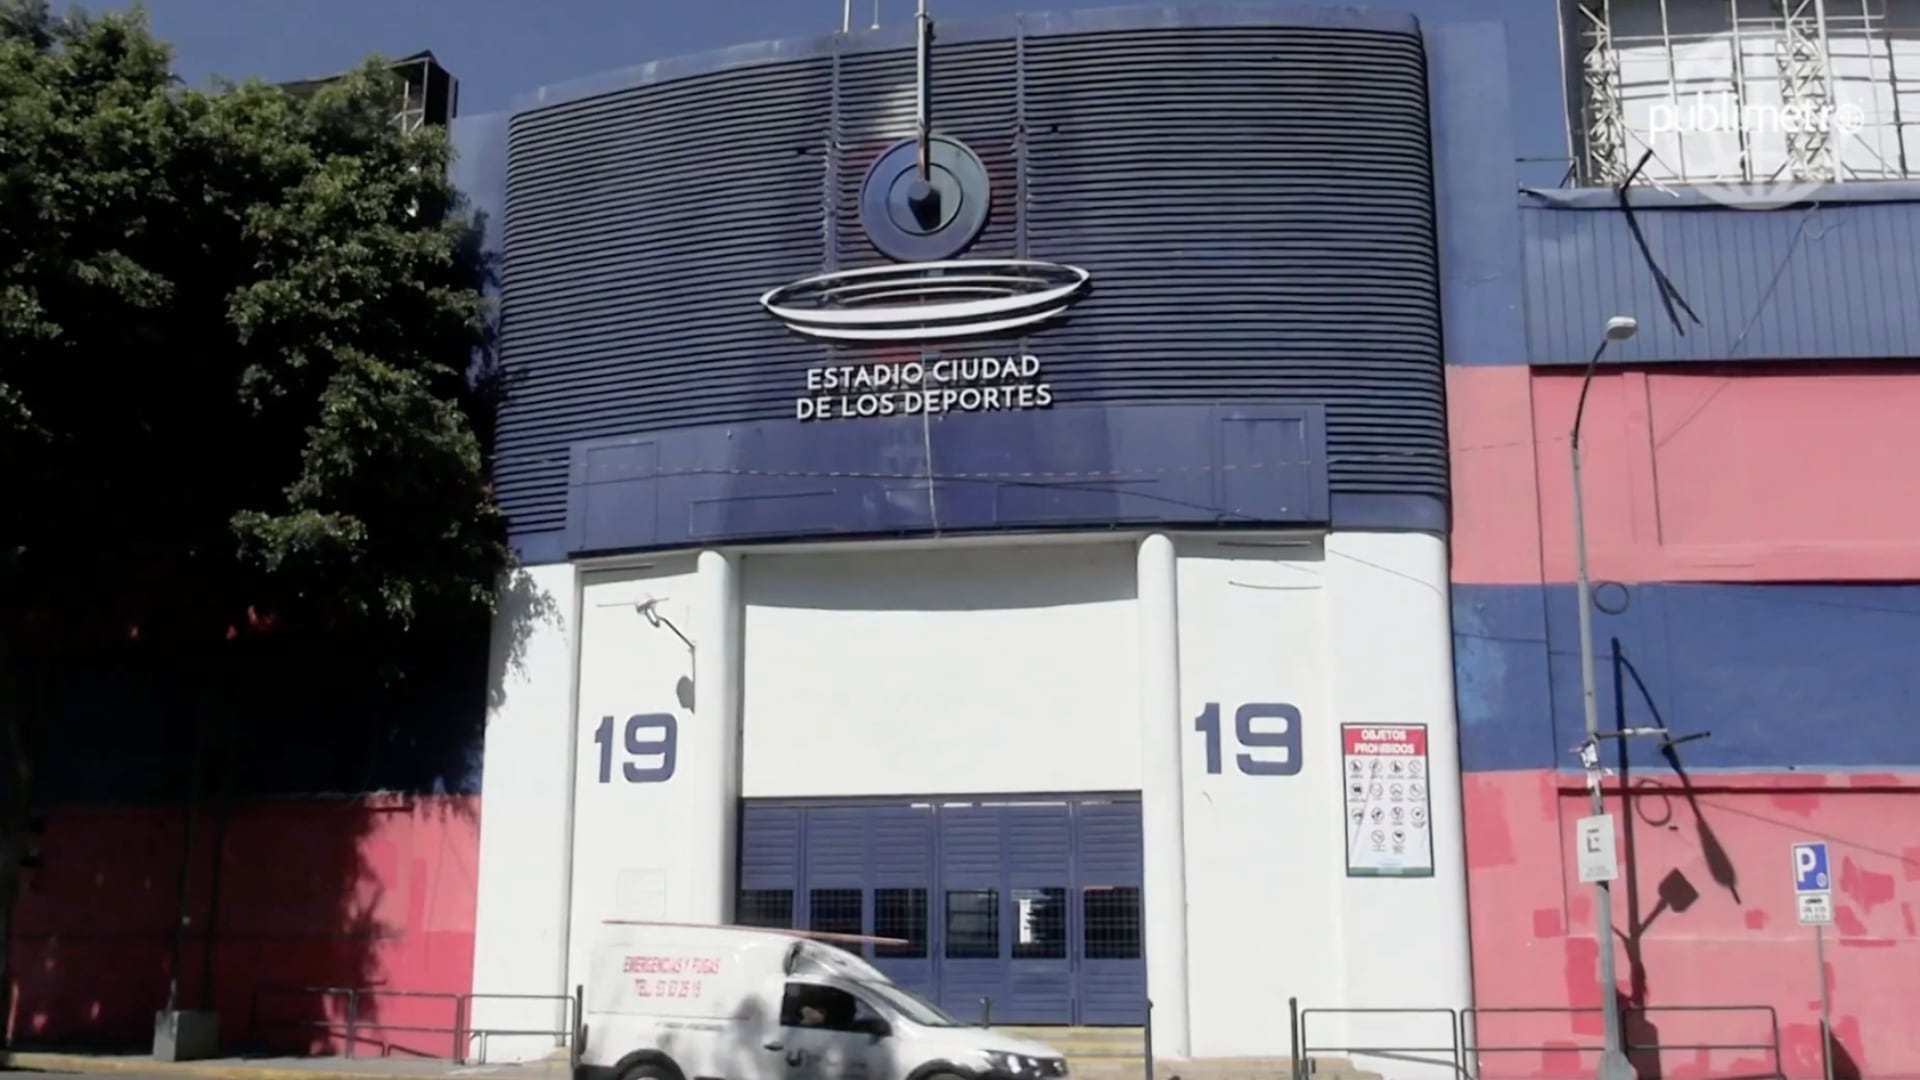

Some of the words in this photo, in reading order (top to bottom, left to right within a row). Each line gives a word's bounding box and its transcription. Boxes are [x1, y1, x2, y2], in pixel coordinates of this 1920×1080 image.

[807, 362, 923, 390] ESTADIO
[932, 355, 1040, 382] CIUDAD
[796, 396, 831, 419] DE
[841, 393, 895, 417] LOS
[904, 384, 1051, 415] DEPORTES
[594, 712, 678, 784] 19
[1194, 702, 1303, 776] 19
[1361, 729, 1406, 741] OBJETOS
[1796, 847, 1816, 883] P
